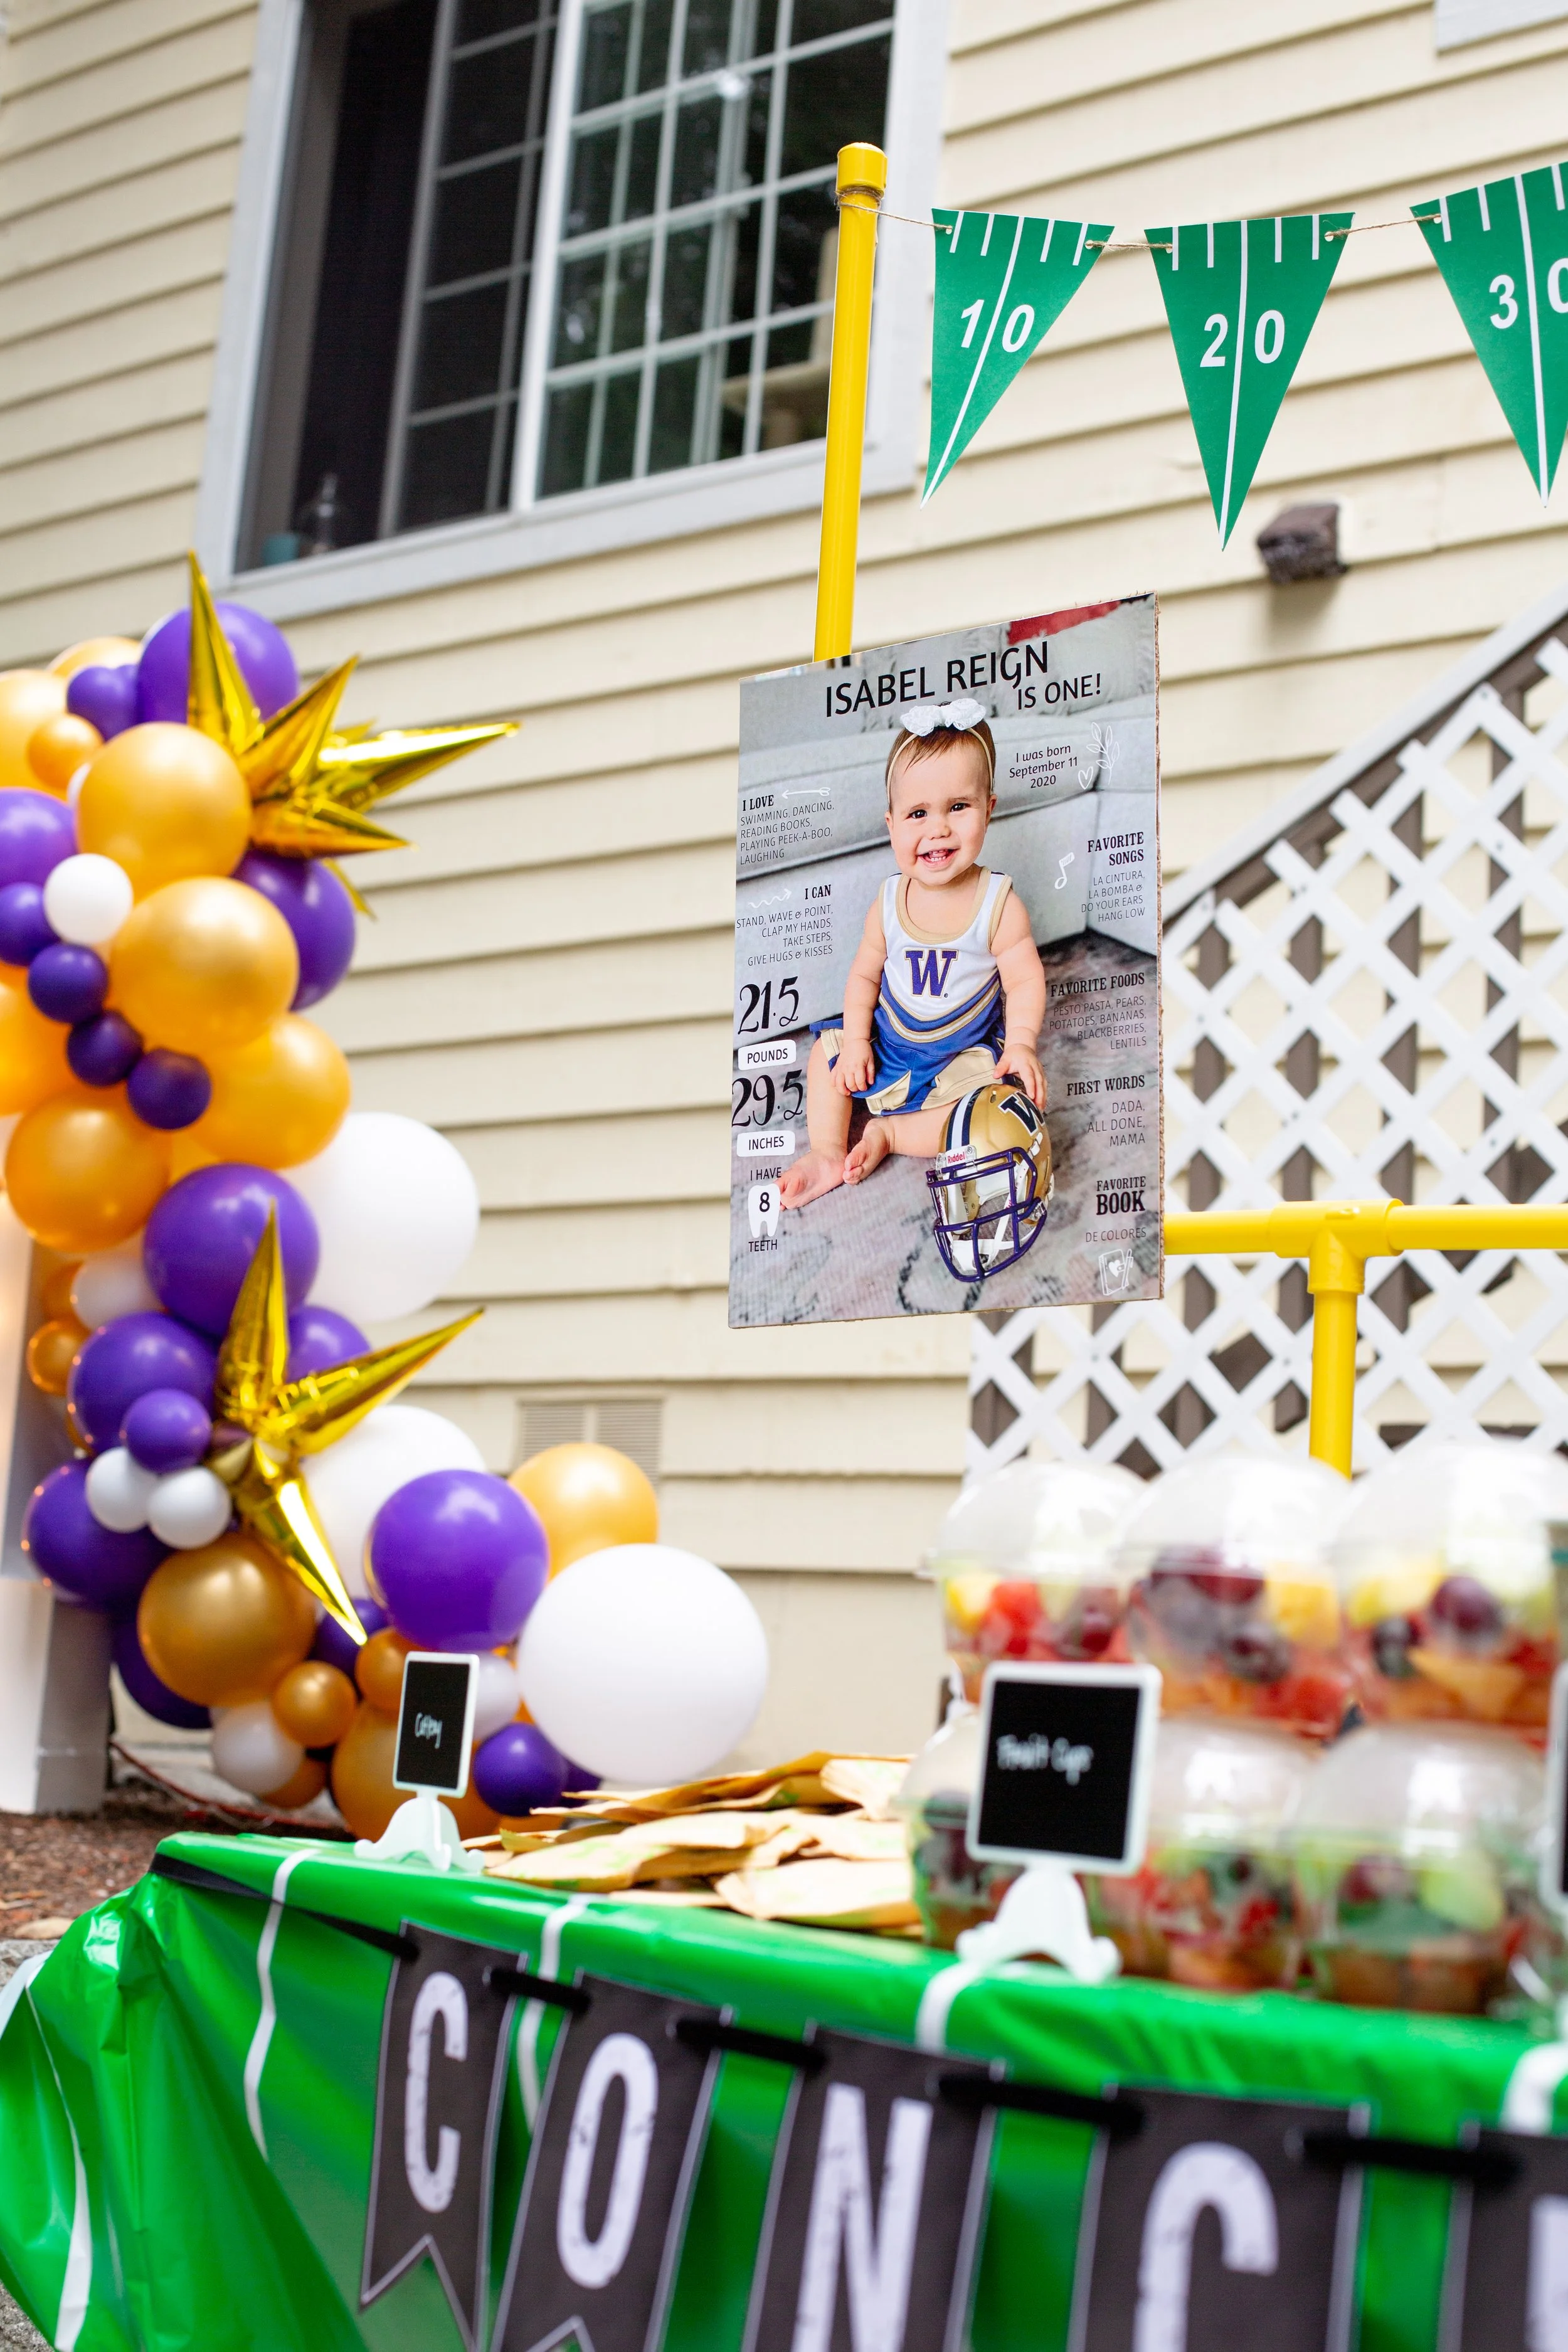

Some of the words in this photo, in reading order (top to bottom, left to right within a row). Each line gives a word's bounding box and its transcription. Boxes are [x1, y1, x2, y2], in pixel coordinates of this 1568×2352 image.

[960, 299, 1035, 353] 10
[1199, 310, 1285, 368] 20
[826, 666, 935, 718] ISABEL
[947, 640, 1048, 693] REIGN
[1018, 686, 1036, 711] IS
[1044, 672, 1101, 704] ONE!
[1022, 751, 1043, 761] was
[1047, 745, 1071, 757] born
[1009, 760, 1065, 778] September
[1068, 756, 1078, 767] 11
[1030, 775, 1056, 788] 2020
[743, 800, 746, 811] I
[750, 795, 774, 810] LOVE
[741, 809, 790, 826] SWIMMING,
[793, 800, 834, 816] DANCING,
[741, 824, 778, 839] READING
[781, 818, 812, 831] BOOKS,
[741, 837, 775, 852] PLAYING
[778, 827, 833, 845] PEEK-A-BOO,
[1088, 832, 1144, 852] FAVORITE
[740, 849, 785, 865] LAUGHING
[1109, 849, 1144, 866] SONGS
[1093, 876, 1103, 886] LA
[1106, 870, 1145, 884] CINTURA,
[805, 888, 808, 899] I
[812, 884, 831, 898] CAN
[1089, 890, 1099, 899] LA
[1102, 884, 1133, 898] BOMBA
[1081, 903, 1093, 913] DO
[1097, 899, 1120, 910] YOUR
[1122, 895, 1143, 906] EARS
[736, 915, 766, 928] STAND,
[768, 911, 793, 923] WAVE
[805, 904, 833, 917] POINT,
[1098, 910, 1123, 922] HANG
[1125, 907, 1145, 918] LOW
[762, 926, 783, 938] CLAP
[785, 923, 798, 934] MY
[801, 918, 833, 931] HANDS,
[783, 936, 803, 947] TAKE
[806, 931, 833, 944] STEPS,
[748, 955, 766, 967] GIVE
[770, 950, 793, 963] HUGS
[805, 945, 833, 957] KISSES
[904, 948, 958, 999] W
[1051, 978, 1106, 997] FAVORITE
[1111, 972, 1145, 988] FOODS
[1054, 1004, 1081, 1016] PESTO
[1084, 1000, 1113, 1012] PASTA,
[1116, 995, 1147, 1008] PEARS,
[1049, 1015, 1097, 1030] POTATOES,
[1100, 1009, 1147, 1024] BANANAS,
[1078, 1023, 1147, 1041] BLACKBERRIES,
[1111, 1036, 1147, 1050] LENTILS
[747, 1048, 788, 1064] POUNDS
[1067, 1080, 1101, 1096] FIRST
[1104, 1075, 1145, 1091] WORDS
[1112, 1099, 1145, 1114] DADA,
[1088, 1120, 1107, 1133] ALL
[1111, 1116, 1145, 1131] DONE,
[749, 1136, 784, 1150] INCHES
[1110, 1133, 1145, 1147] MAMA
[756, 1167, 781, 1180] HAVE
[1096, 1176, 1147, 1192] FAVORITE
[759, 1192, 770, 1212] 8
[1096, 1190, 1145, 1216] BOOK
[1086, 1232, 1098, 1242] DE
[1101, 1227, 1147, 1241] COLORES
[748, 1239, 778, 1252] TEETH
